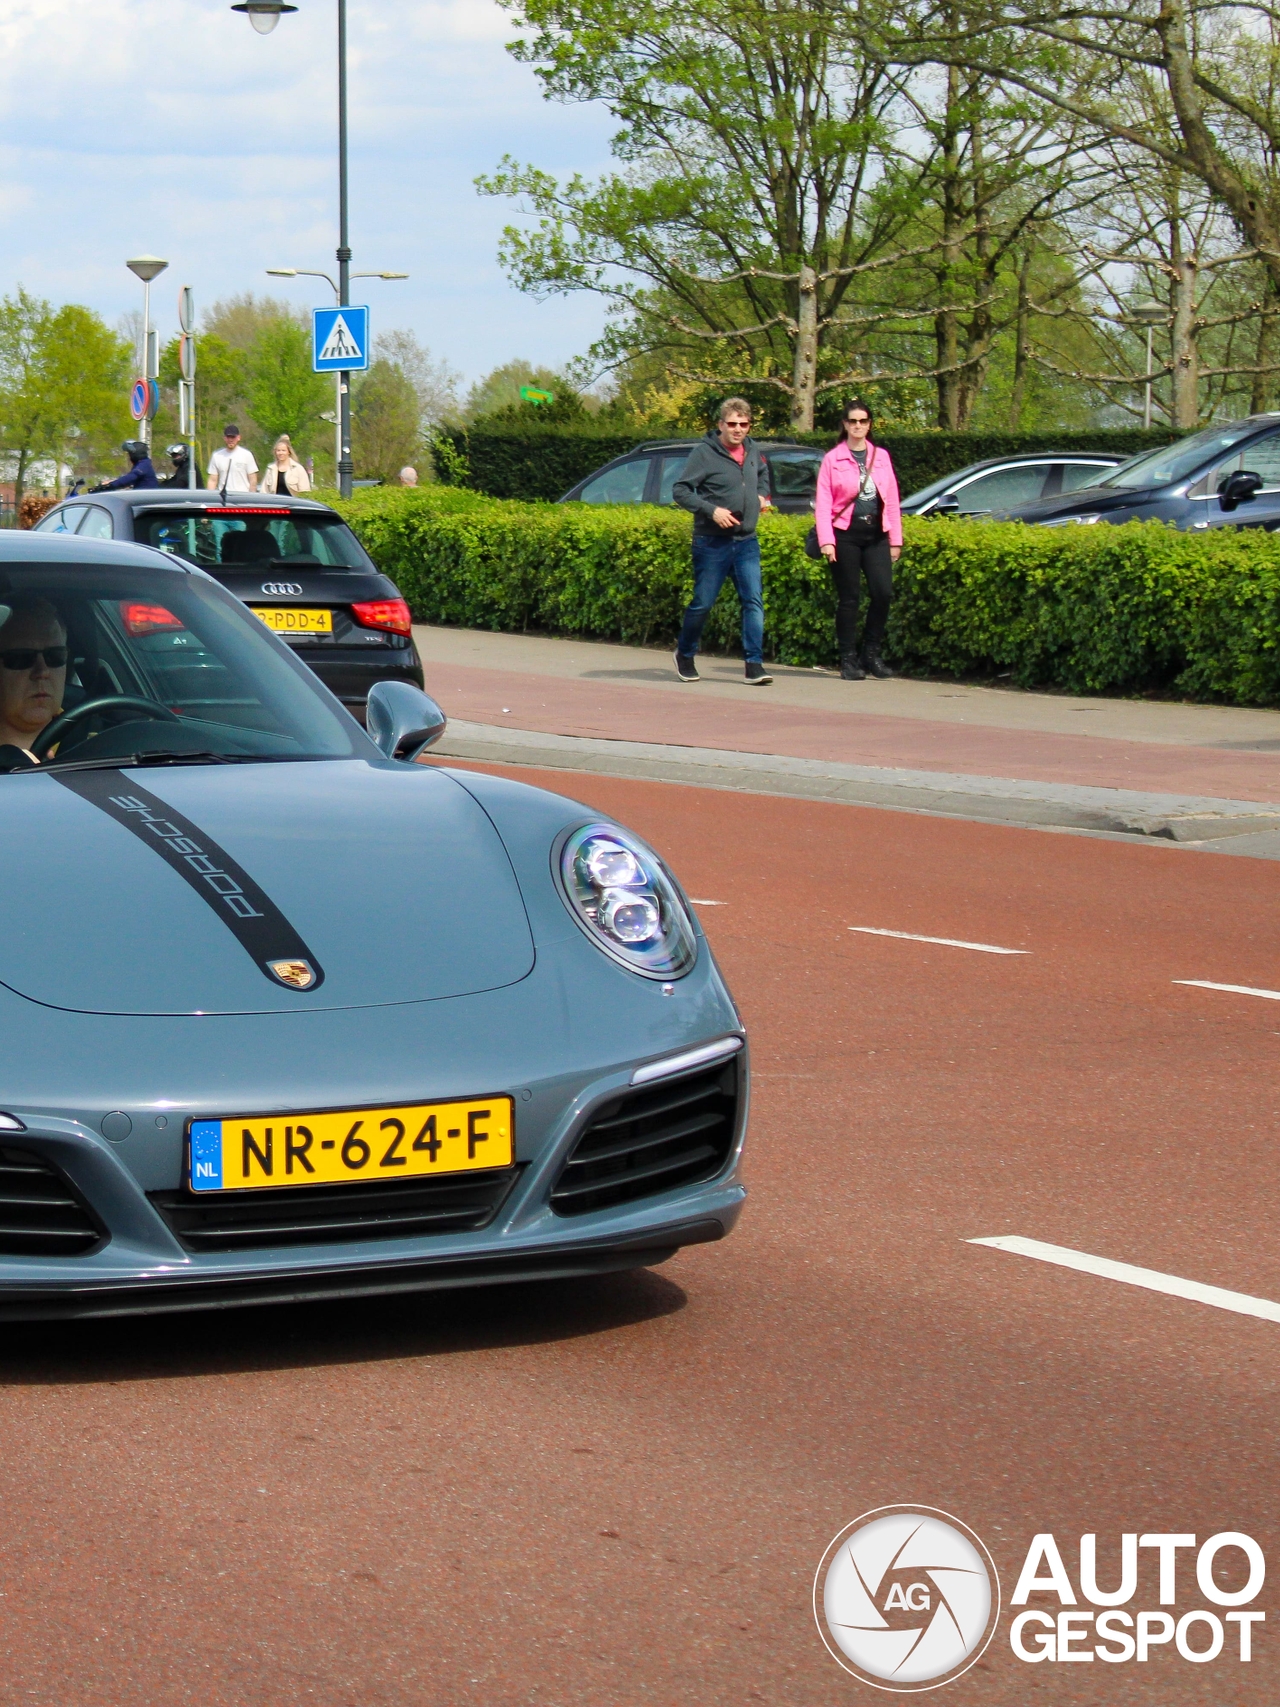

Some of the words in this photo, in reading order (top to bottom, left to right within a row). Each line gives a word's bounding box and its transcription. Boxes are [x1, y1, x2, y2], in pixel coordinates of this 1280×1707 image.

[108, 795, 265, 918] PORSCHE
[196, 1162, 219, 1179] NL
[241, 1109, 492, 1178] NR-624-F
